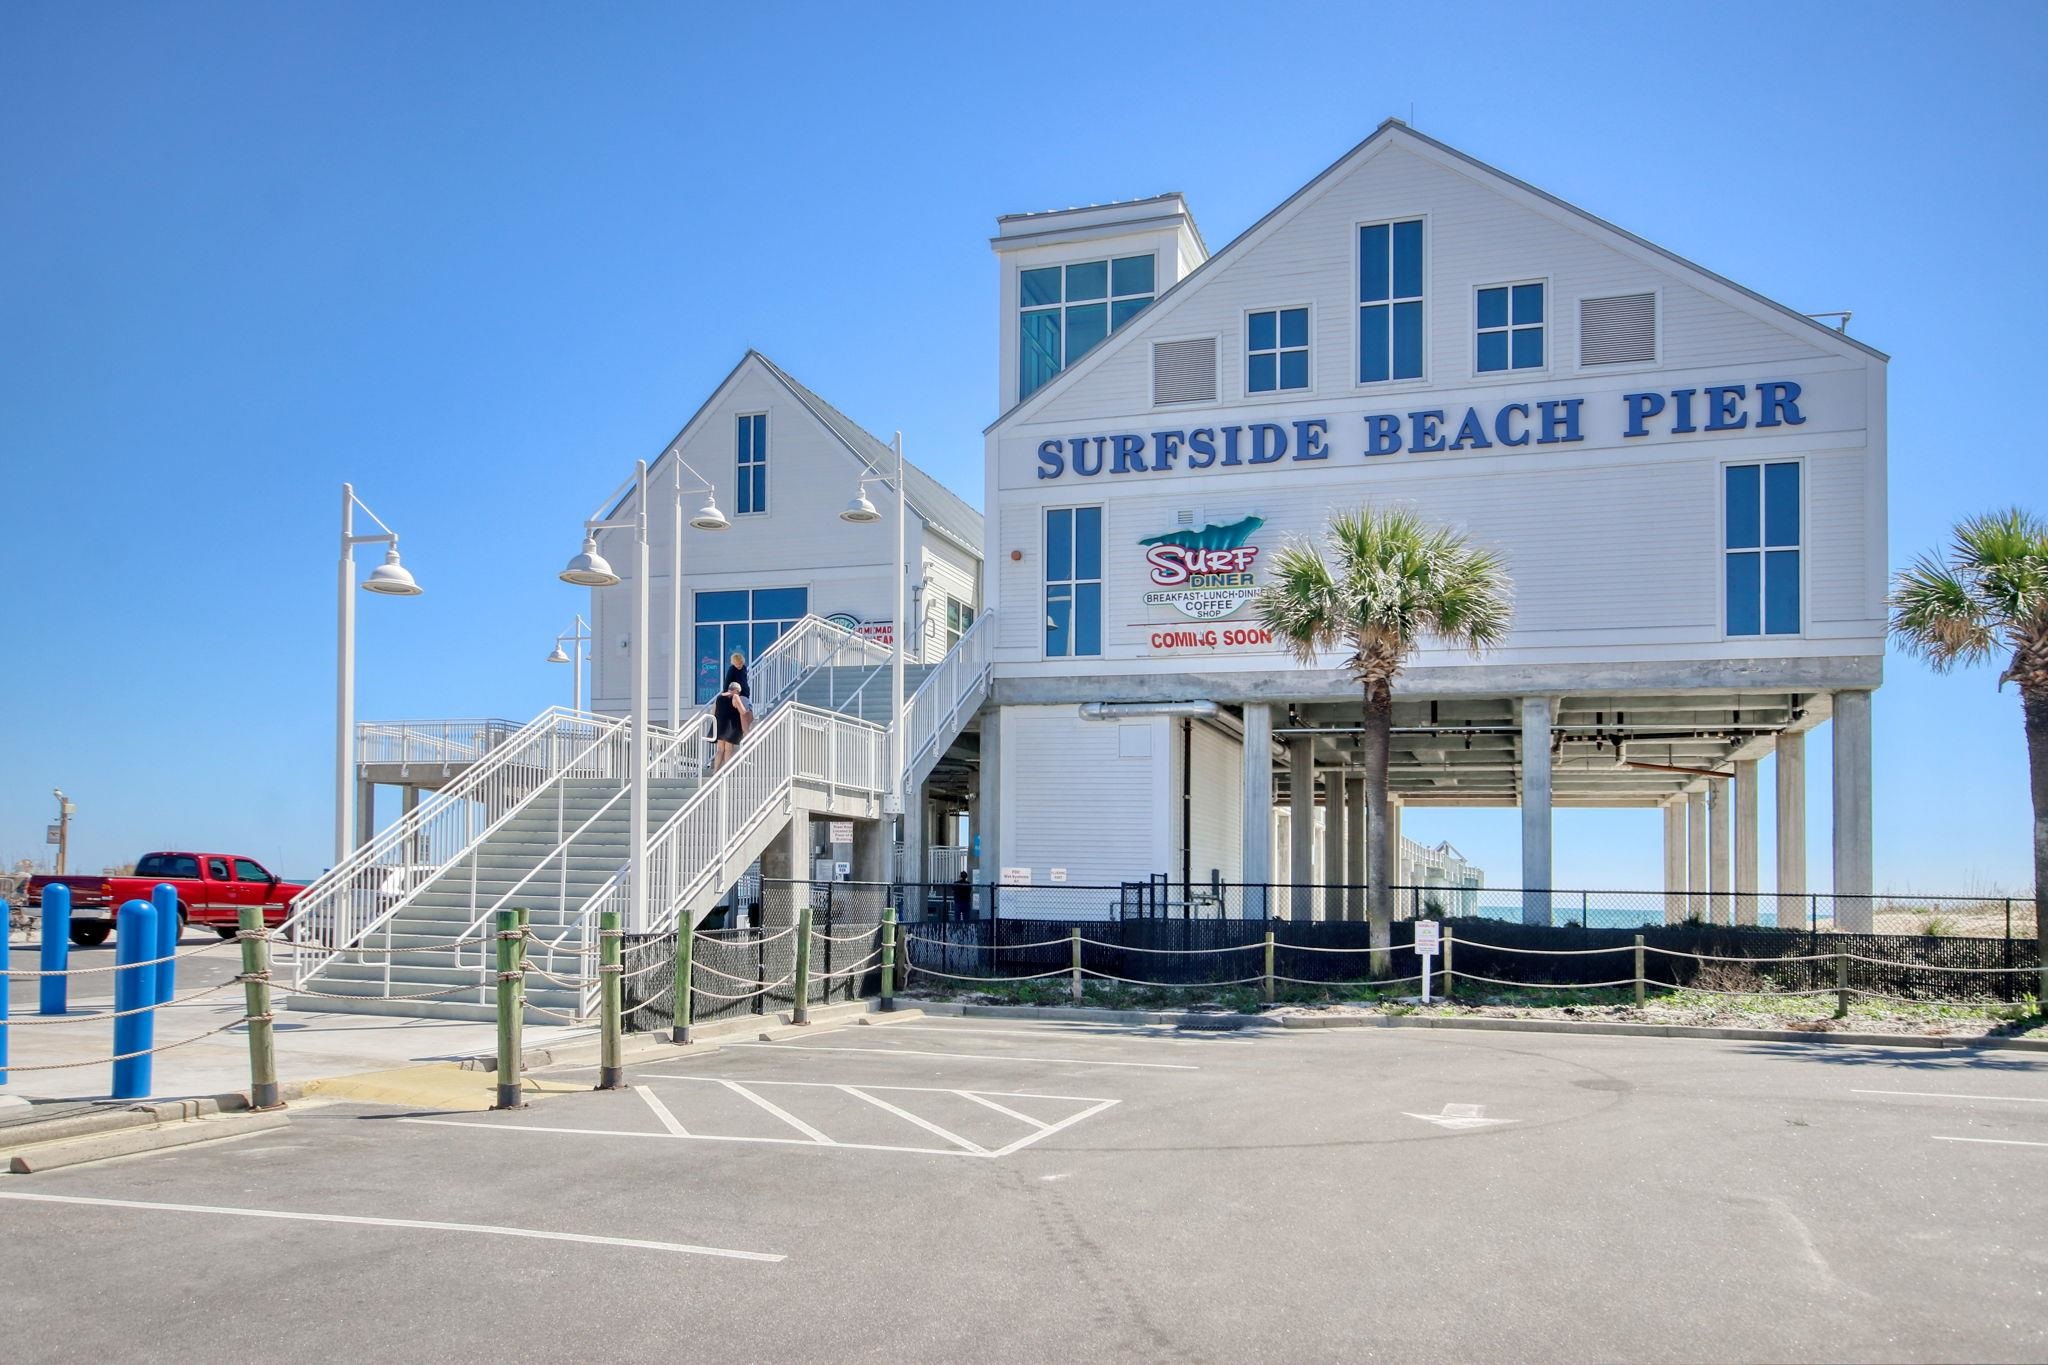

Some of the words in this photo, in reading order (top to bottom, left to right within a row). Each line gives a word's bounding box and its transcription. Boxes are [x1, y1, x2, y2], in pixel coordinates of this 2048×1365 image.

[1037, 418, 1329, 480] SURFSIDE
[1363, 398, 1585, 457] BEACH
[1623, 381, 1807, 438] PIER
[1146, 542, 1259, 586] SURF
[1190, 573, 1254, 588] DINER
[1185, 600, 1233, 611] COFFEE
[1197, 610, 1221, 618] SHOP
[1151, 630, 1218, 649] COMING
[1223, 628, 1273, 646] SOON
